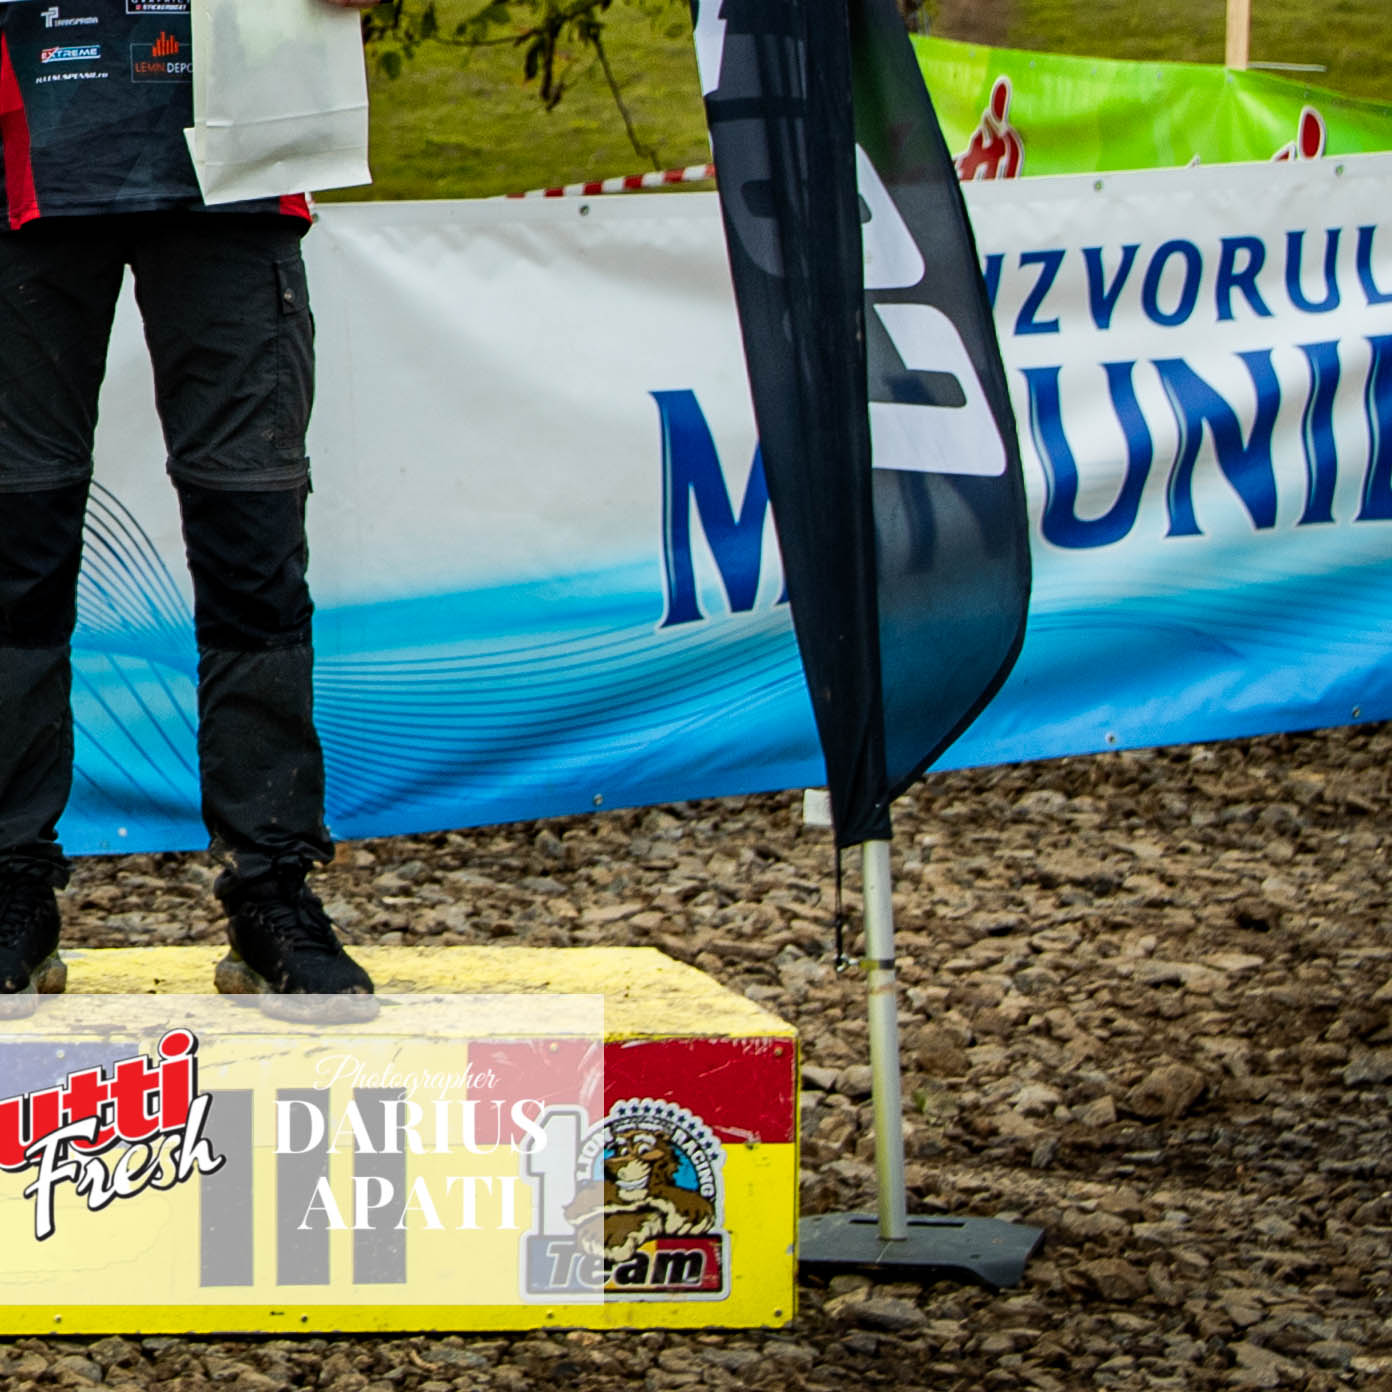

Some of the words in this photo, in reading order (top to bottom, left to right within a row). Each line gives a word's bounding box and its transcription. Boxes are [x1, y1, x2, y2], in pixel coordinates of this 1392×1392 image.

[41, 48, 99, 59] EXTREME
[671, 1129, 715, 1198] RACING
[547, 1241, 705, 1288] Team
